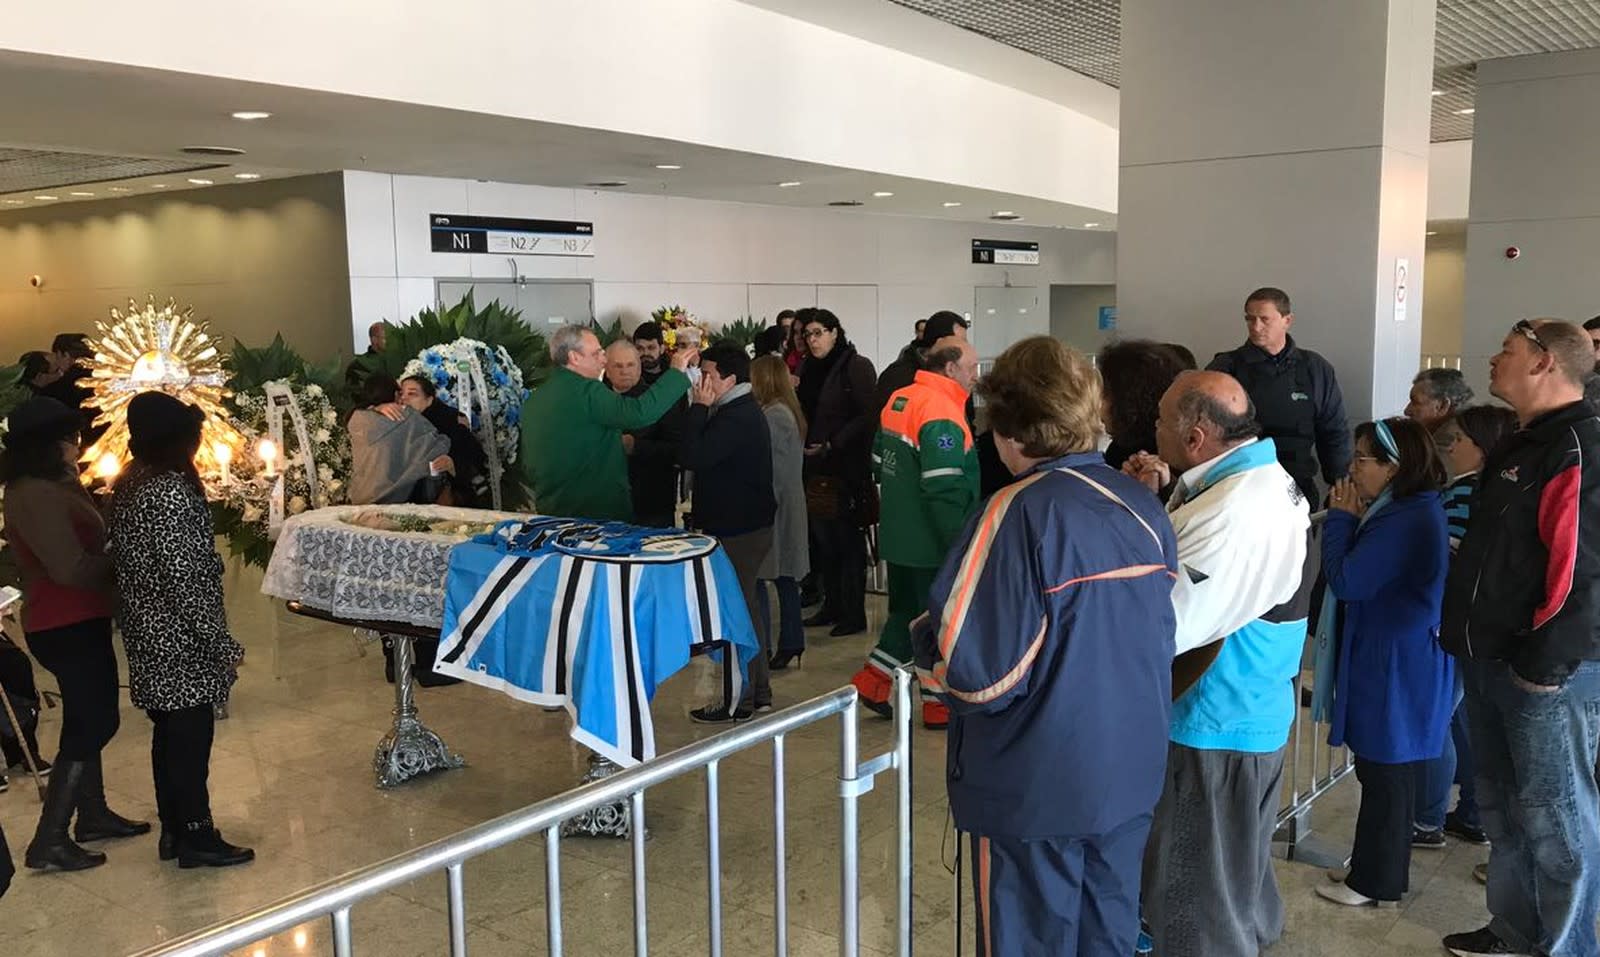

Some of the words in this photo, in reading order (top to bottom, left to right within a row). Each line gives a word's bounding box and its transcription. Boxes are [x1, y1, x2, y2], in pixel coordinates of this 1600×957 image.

[452, 233, 471, 249] N1
[511, 236, 527, 249] N2
[563, 239, 577, 252] N3
